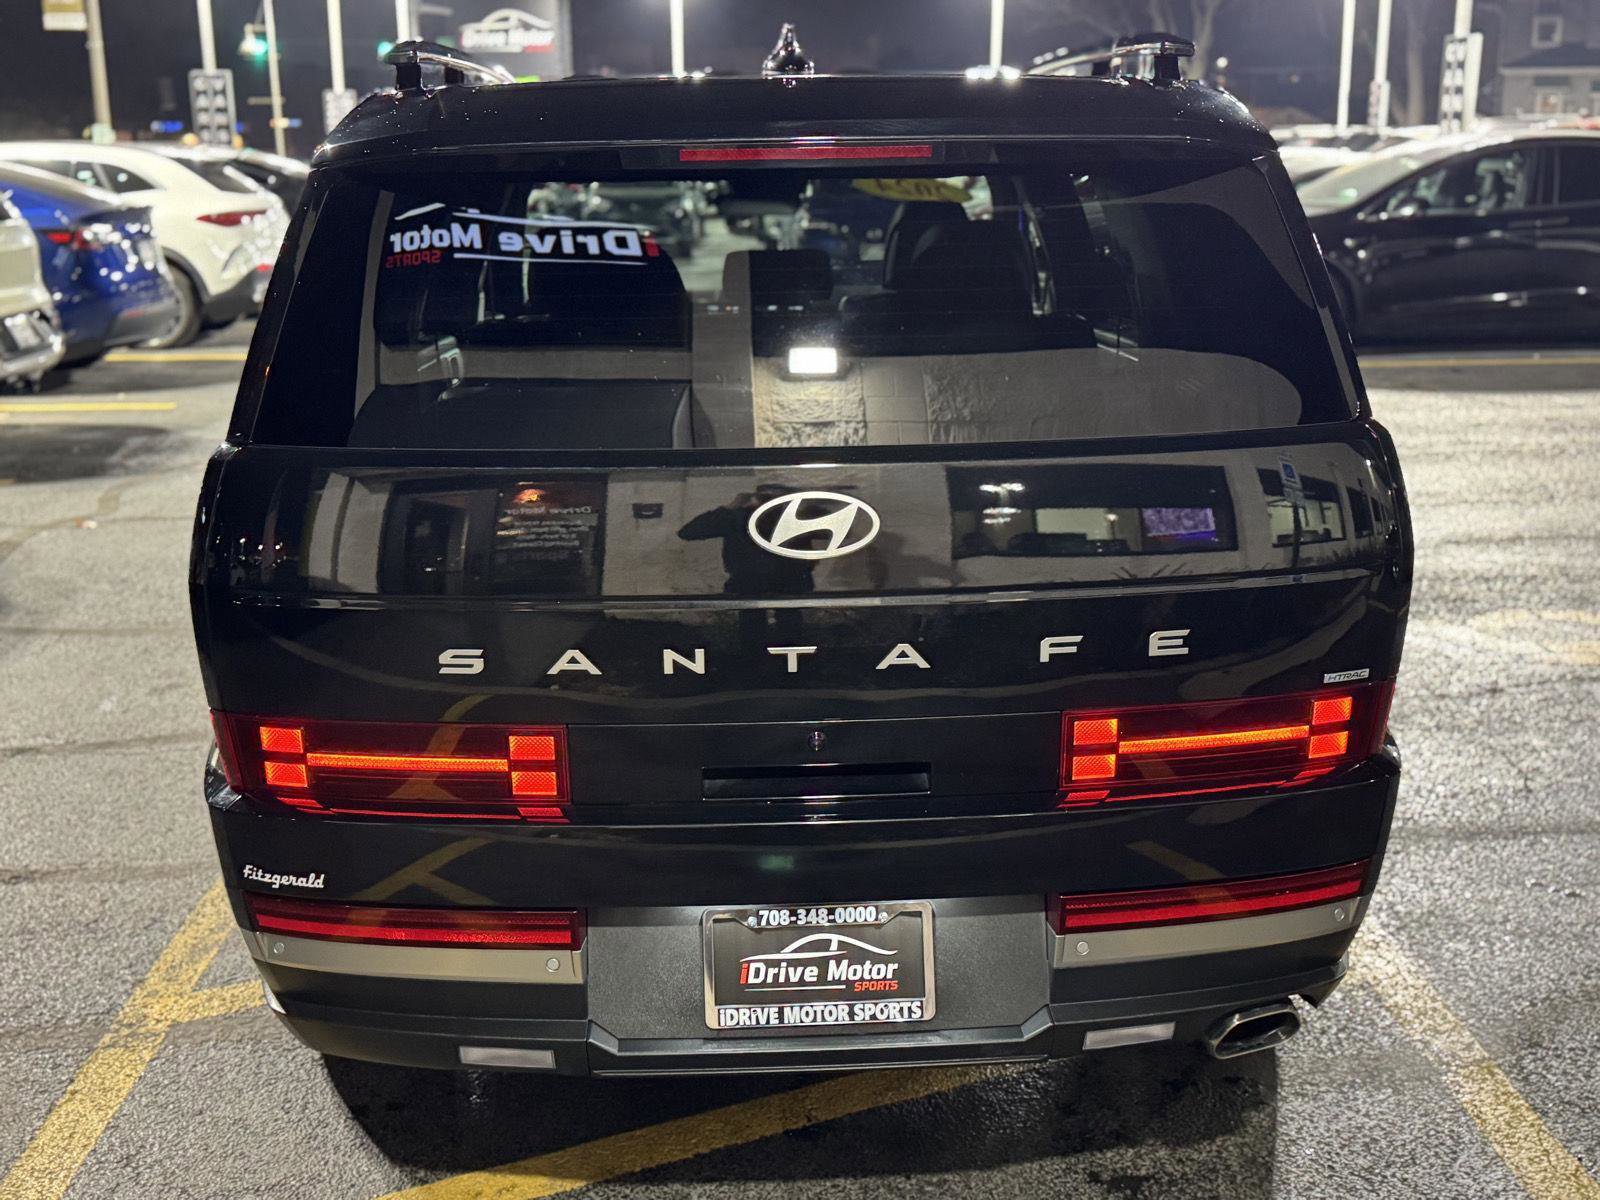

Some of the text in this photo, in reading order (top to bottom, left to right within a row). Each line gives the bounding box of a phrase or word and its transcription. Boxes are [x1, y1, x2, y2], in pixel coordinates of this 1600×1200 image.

[438, 629, 1191, 675] SANTA FE
[1325, 669, 1368, 682] HTRAC
[243, 864, 325, 889] Fitzgerald
[758, 906, 877, 927] 708-348-0000
[739, 959, 899, 985] iDrive Motor
[854, 980, 899, 992] SPORTS
[783, 1004, 850, 1025] MOTOR
[854, 1000, 923, 1022] SPORTS
